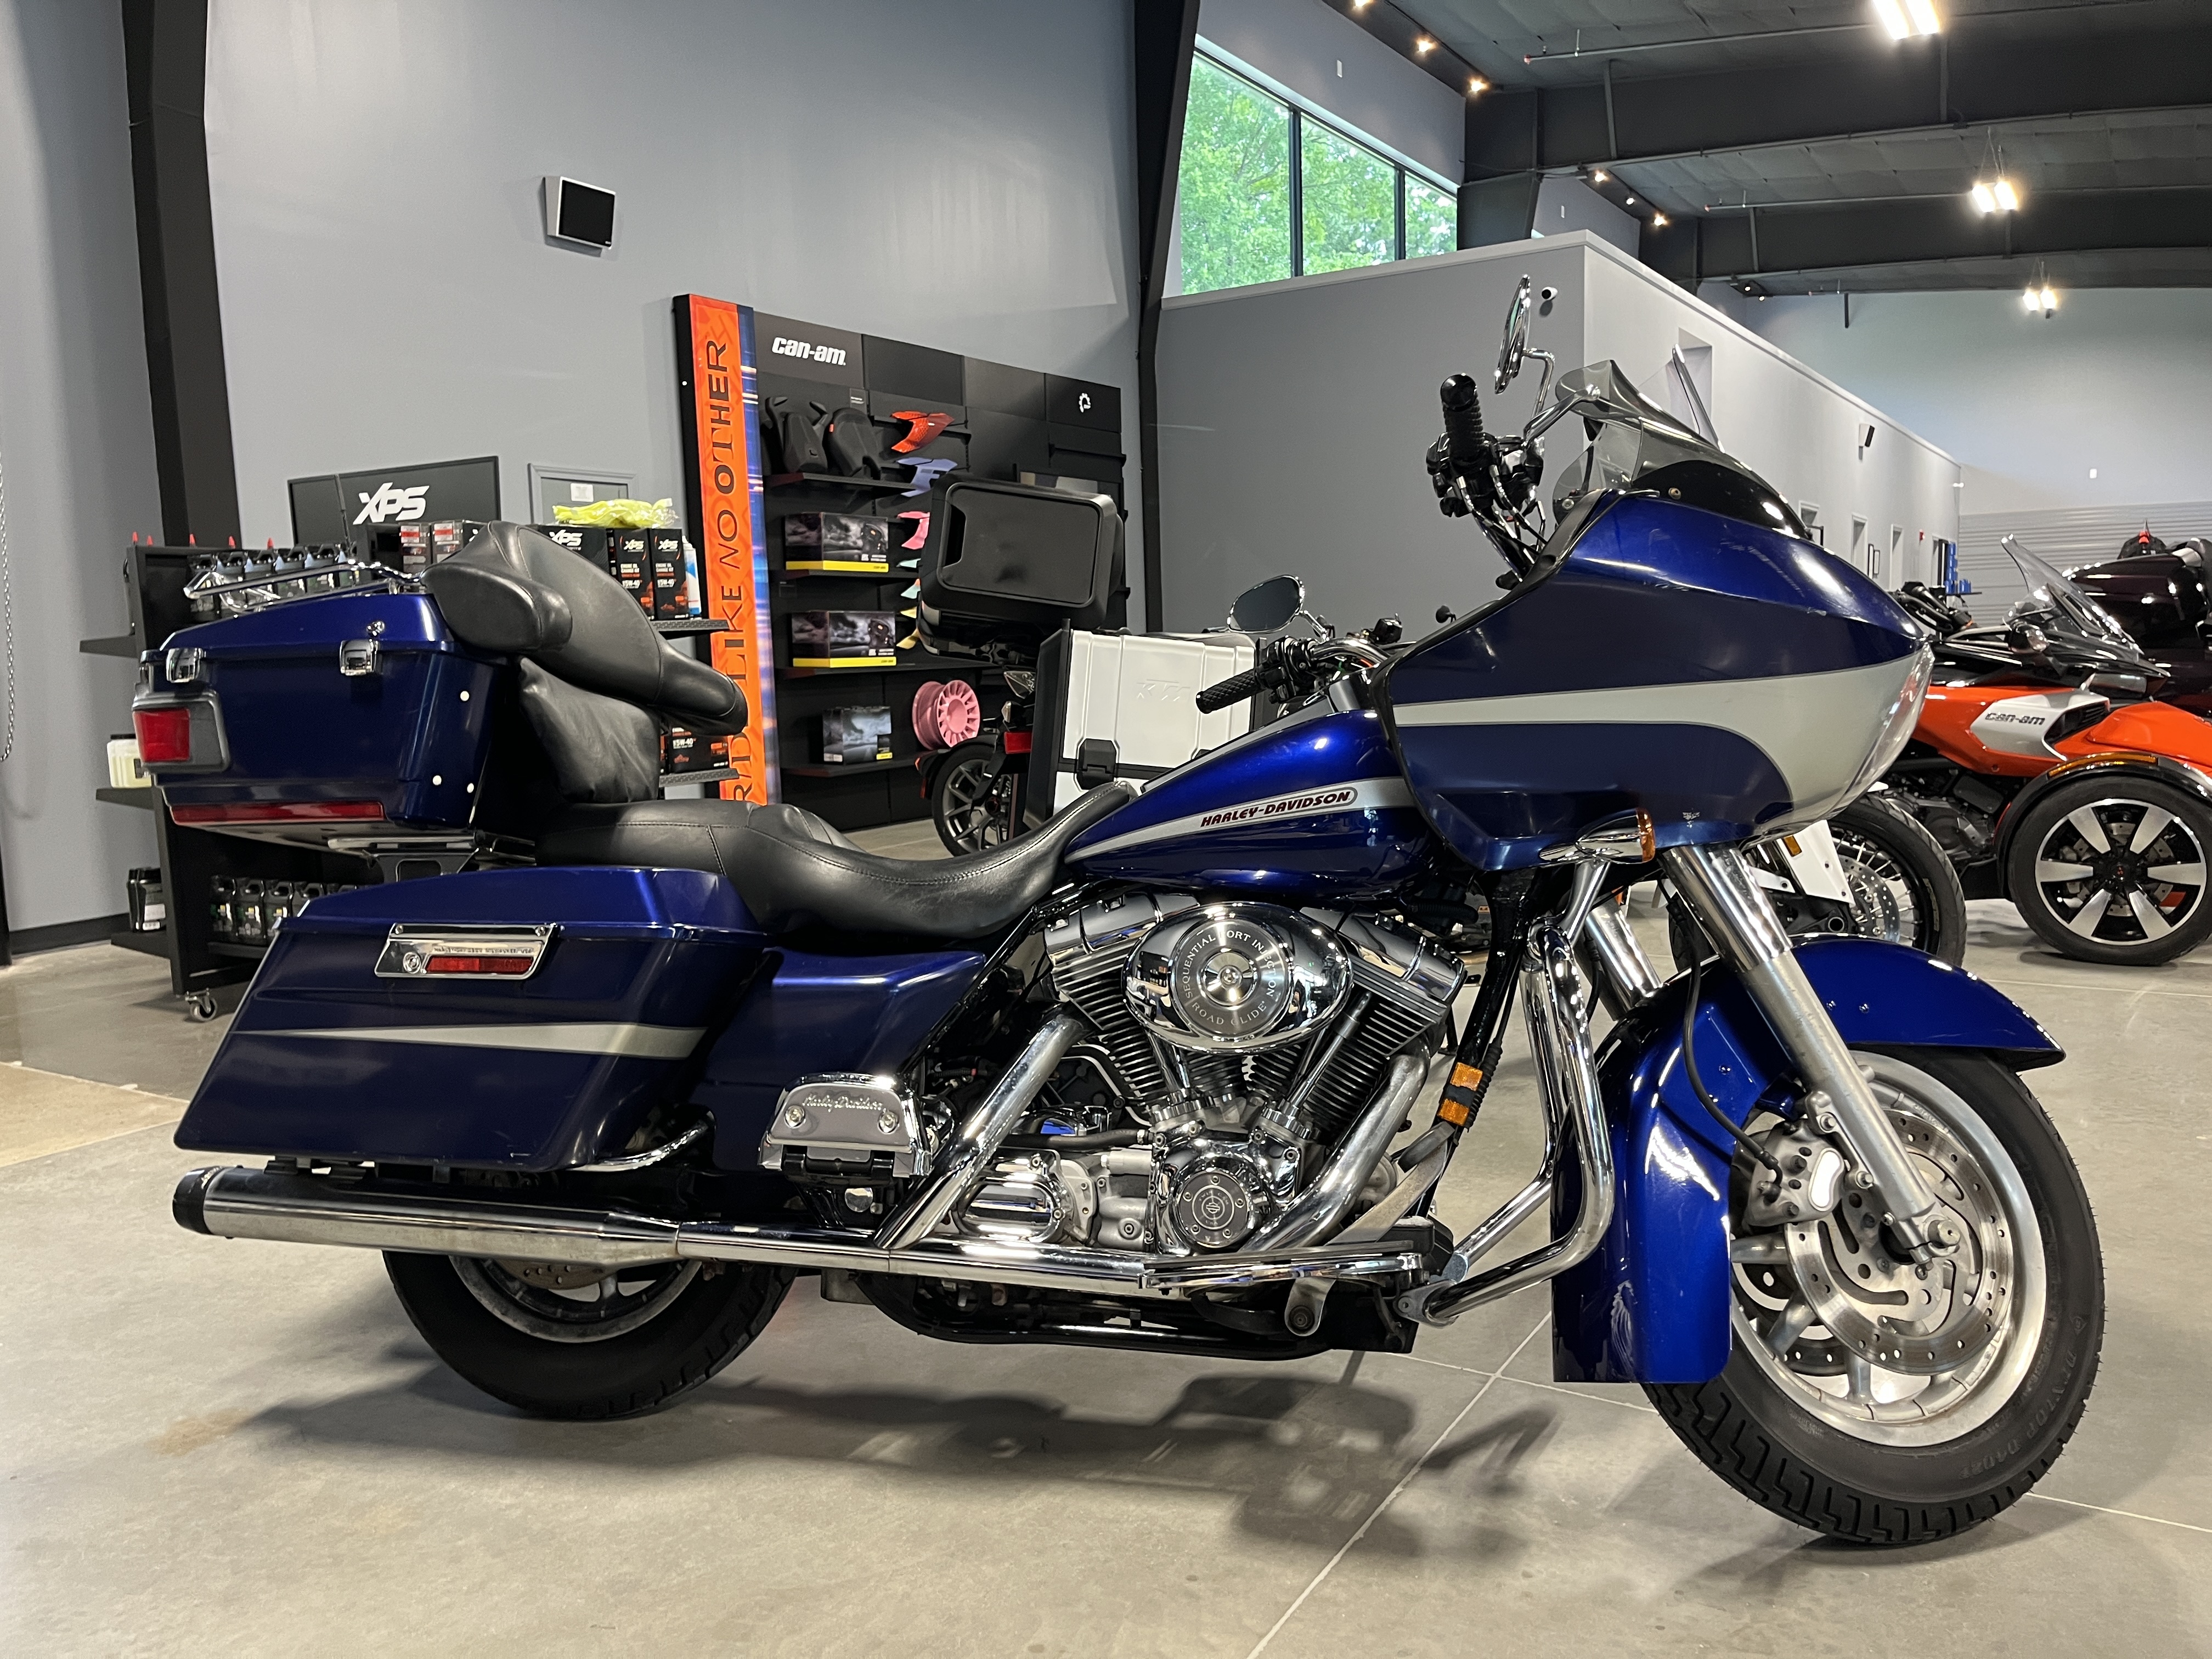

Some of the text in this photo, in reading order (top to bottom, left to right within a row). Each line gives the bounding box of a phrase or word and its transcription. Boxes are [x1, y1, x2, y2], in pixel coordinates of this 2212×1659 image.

[353, 482, 430, 525] XPS
[549, 529, 583, 546] XPS
[623, 539, 644, 550] XPS
[658, 539, 678, 550] XPS
[706, 340, 752, 800] RID LIKE NO OTHER
[1136, 679, 1192, 703] KTM
[1985, 712, 2045, 725] can-am
[1200, 791, 1351, 827] HARLEY-DAVIDSON
[1181, 934, 1216, 998] SEQUENTIAL
[1251, 939, 1277, 997] INJECTON
[1192, 1002, 1224, 1025] ROAD
